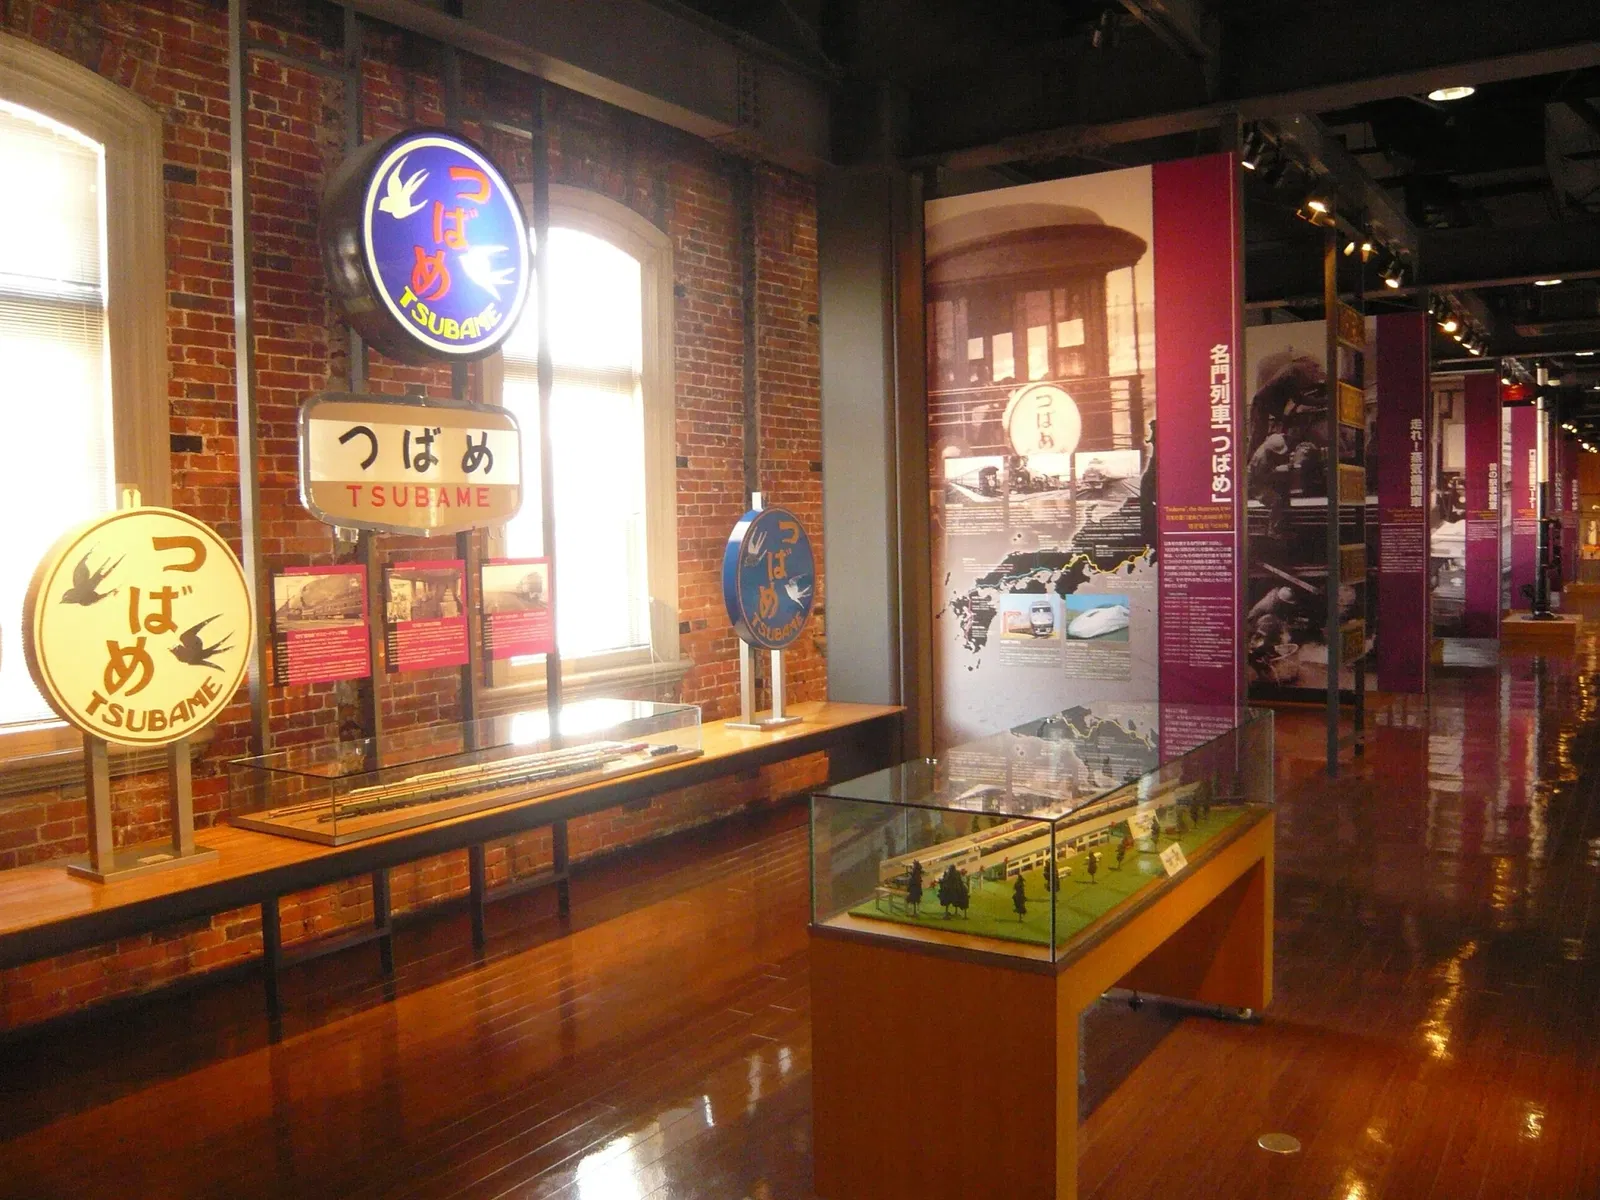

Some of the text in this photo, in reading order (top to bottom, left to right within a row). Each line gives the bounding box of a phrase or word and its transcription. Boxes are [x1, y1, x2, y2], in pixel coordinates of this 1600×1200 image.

[411, 165, 492, 301] つばめ
[399, 285, 503, 340] TSUBAME
[338, 425, 494, 475] つばめ
[1210, 344, 1232, 503] 名門列車「つばめ」
[346, 484, 491, 508] TSUBAME
[759, 520, 800, 620] つばめ
[103, 535, 207, 697] つばめ
[751, 610, 805, 641] TSUBAME
[85, 675, 223, 733] TSUBAME
